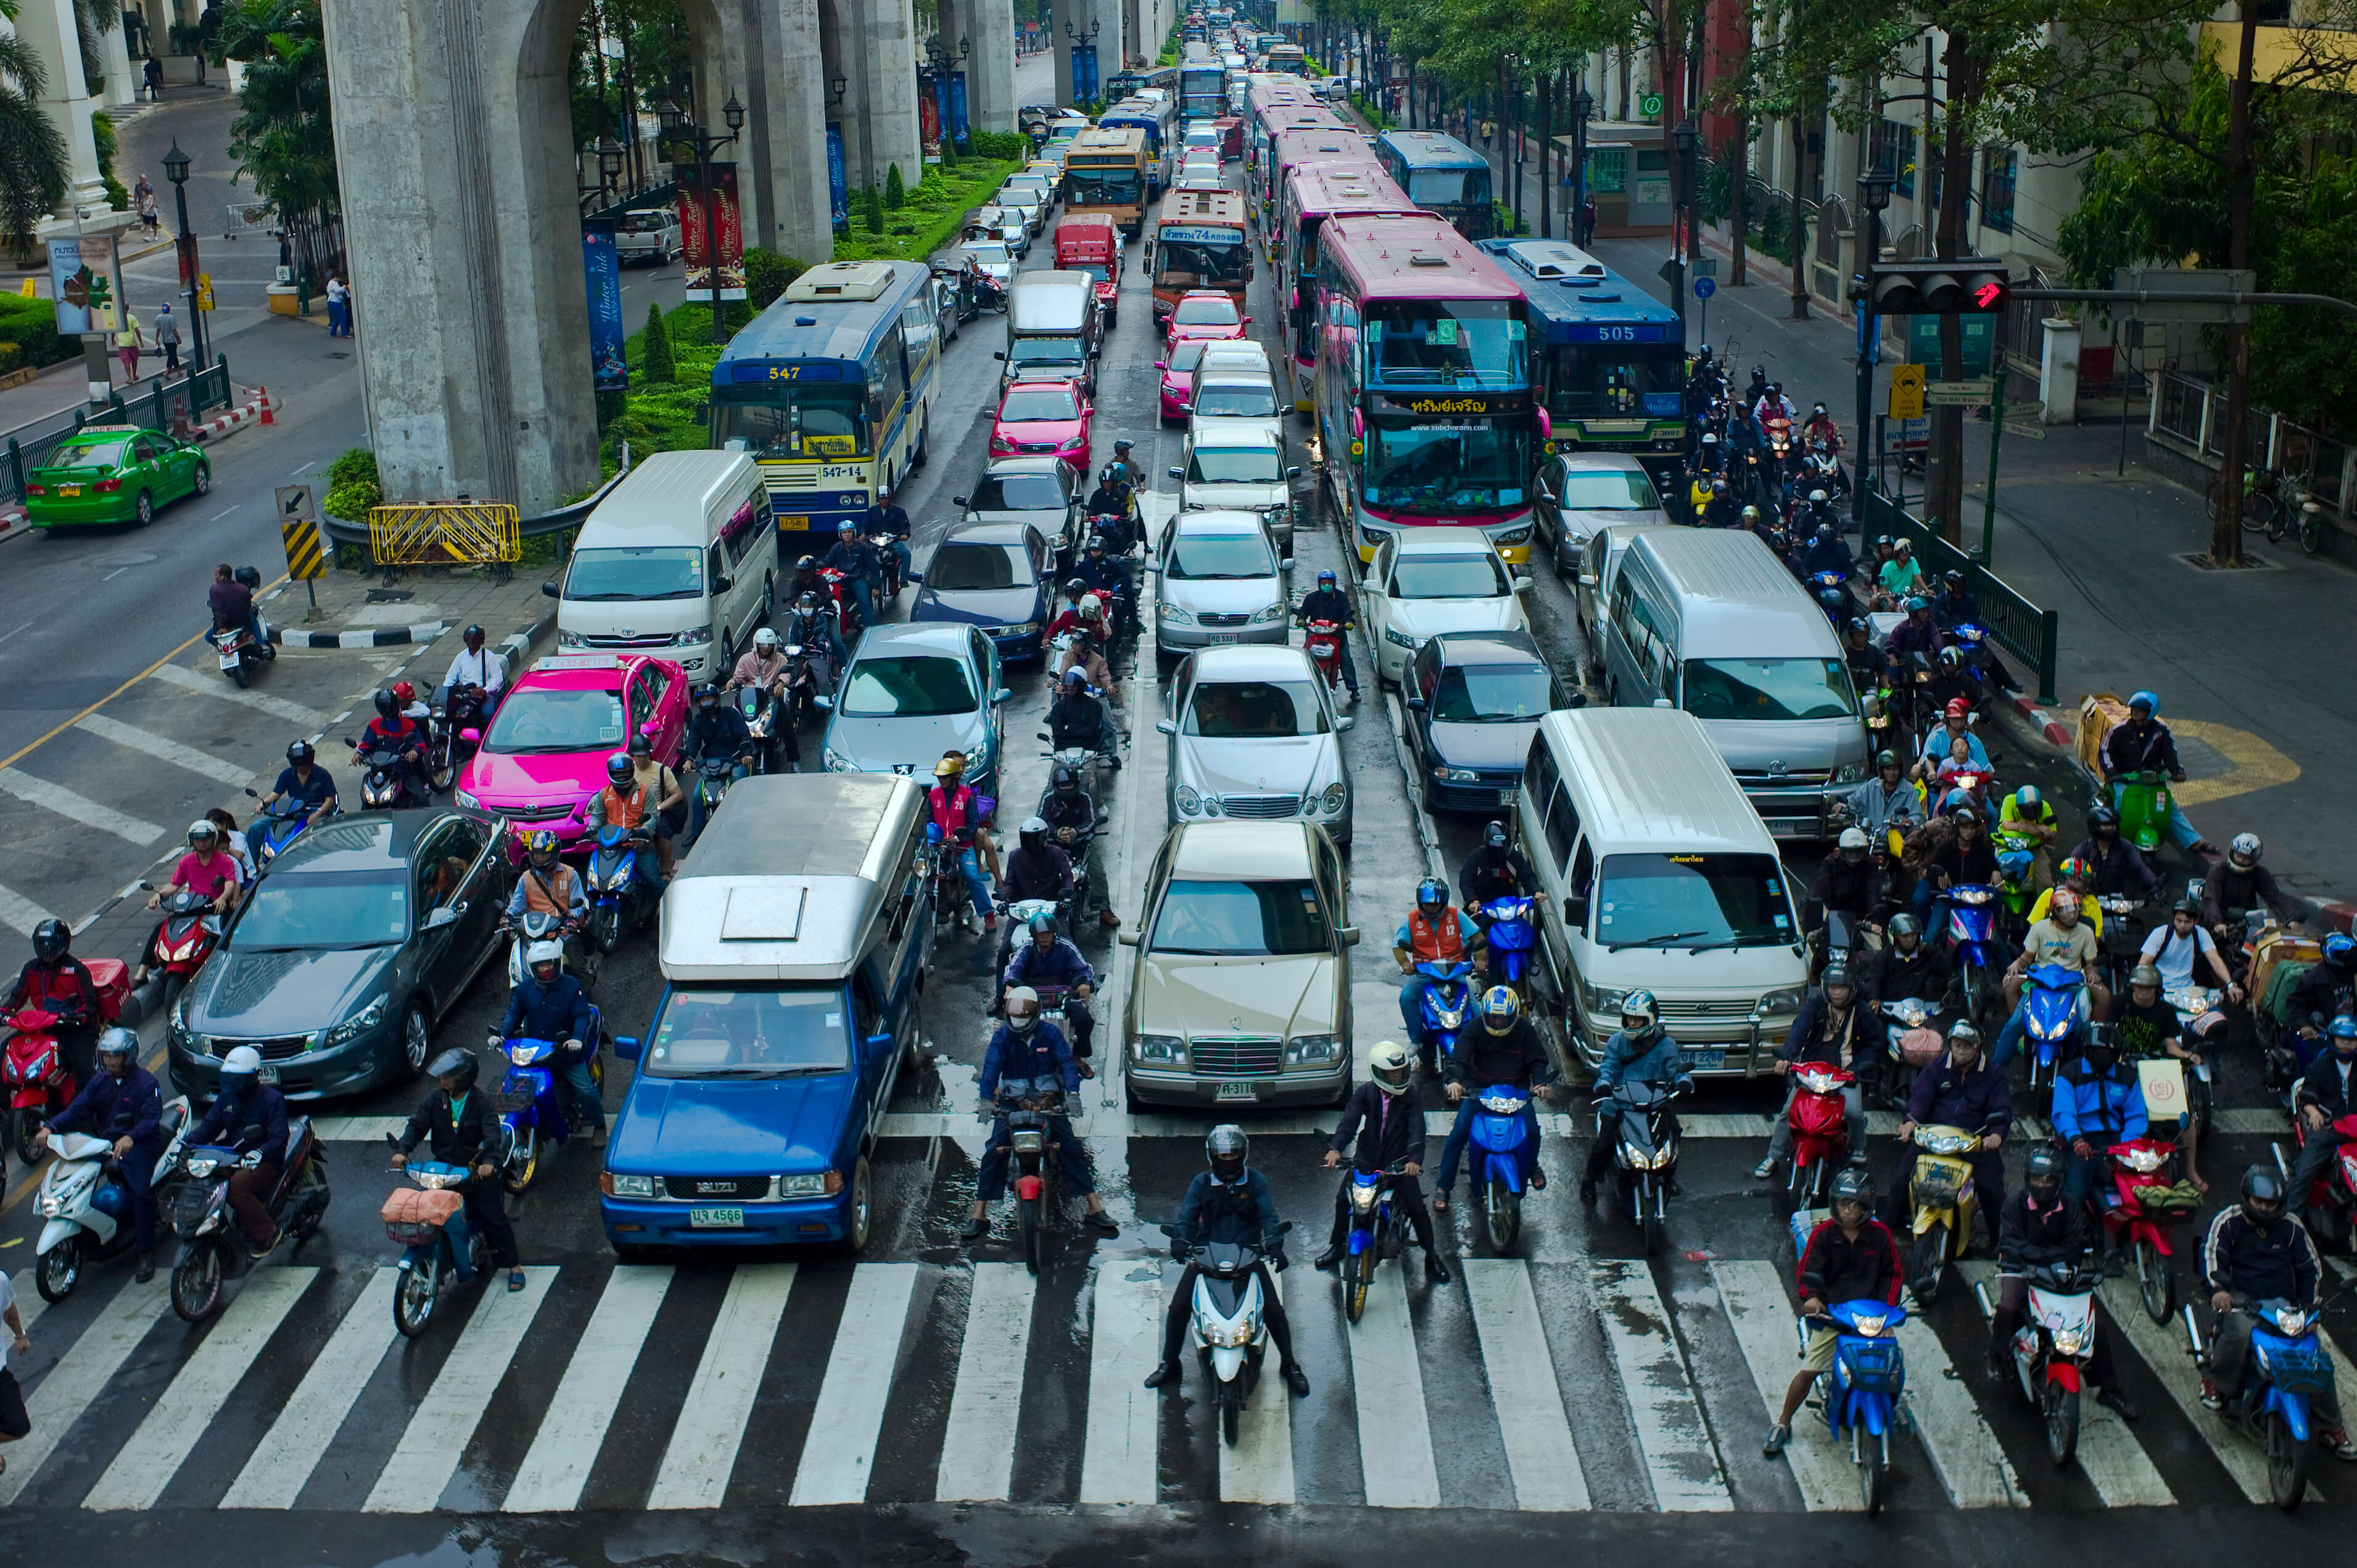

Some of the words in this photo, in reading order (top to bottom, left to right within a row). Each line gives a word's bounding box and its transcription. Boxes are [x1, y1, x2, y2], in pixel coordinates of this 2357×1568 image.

[1195, 229, 1210, 240] 74
[1599, 327, 1634, 340] 505
[769, 367, 801, 379] 547
[1411, 399, 1487, 413] ทรัพย์เจริญ
[822, 466, 862, 477] 547-14
[553, 658, 609, 667] TAXI-METER
[631, 790, 639, 805] 9
[954, 801, 964, 810] 20
[559, 880, 568, 890] 10
[1446, 925, 1455, 935] 12
[1699, 1052, 1723, 1062] 2268
[696, 1181, 738, 1193] ISUZU
[713, 1209, 741, 1220] 4566
